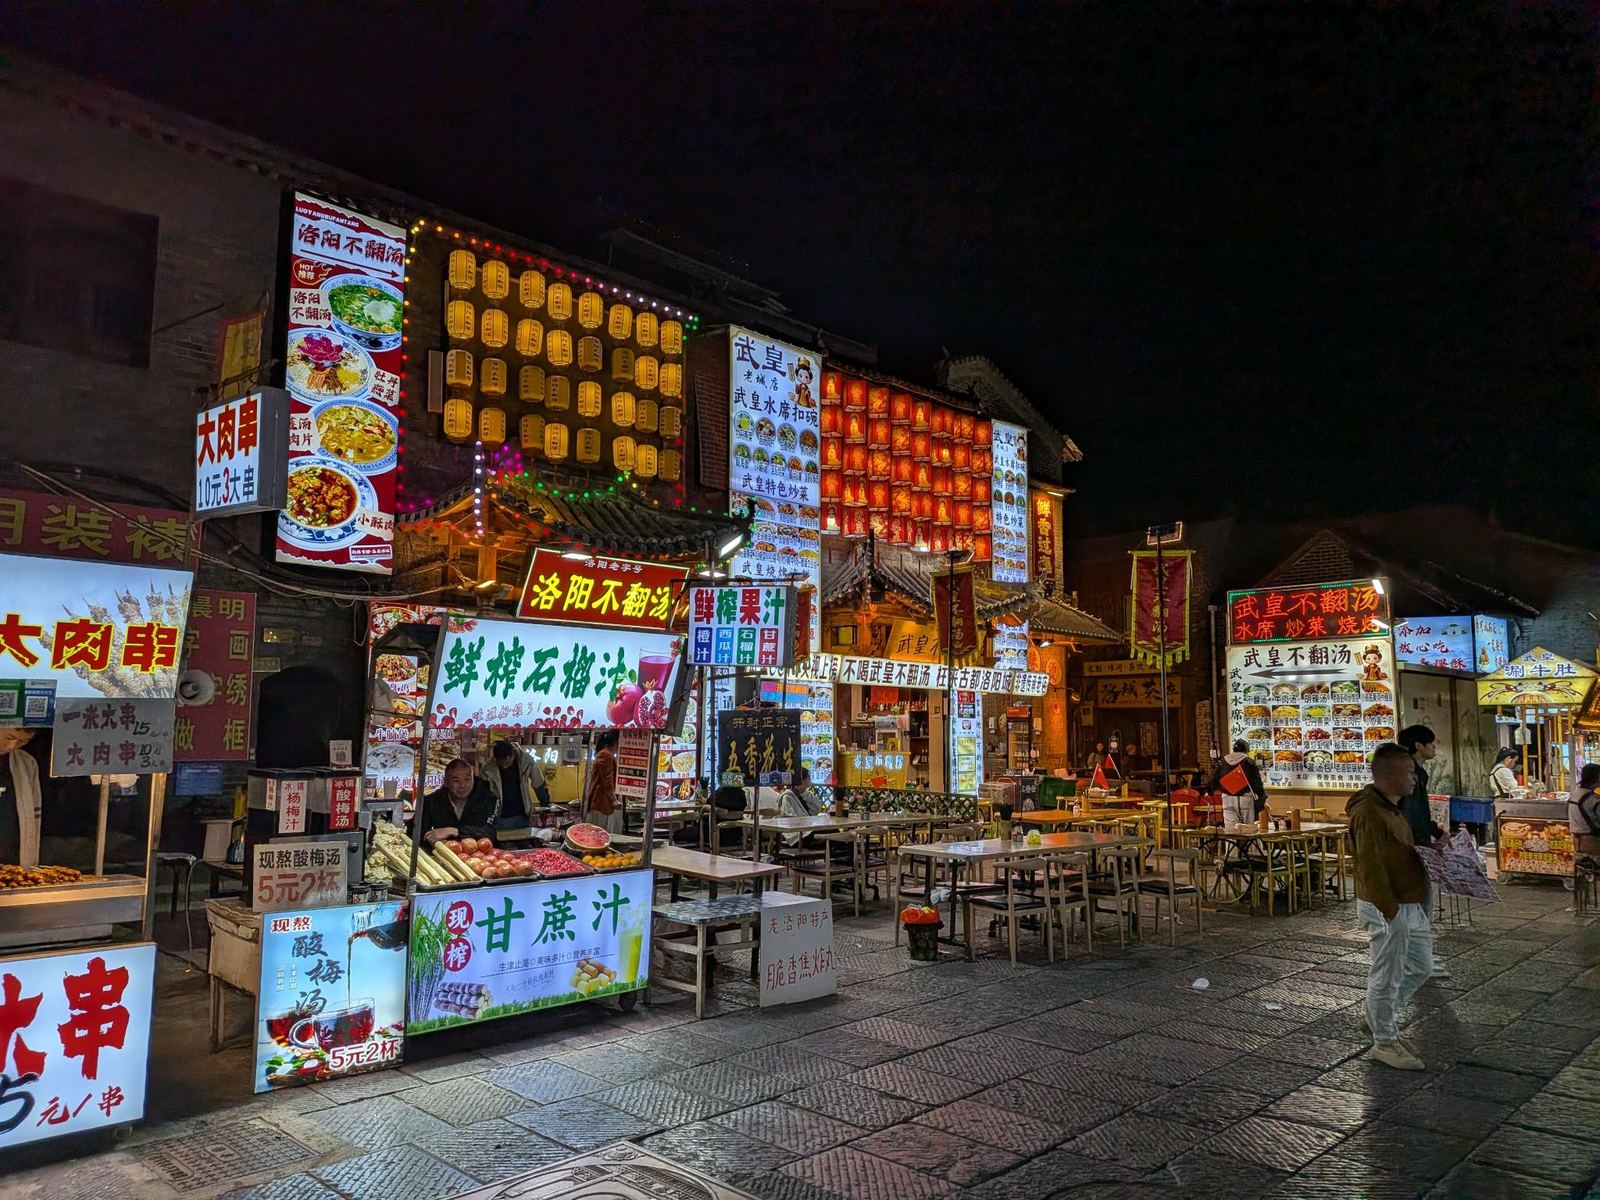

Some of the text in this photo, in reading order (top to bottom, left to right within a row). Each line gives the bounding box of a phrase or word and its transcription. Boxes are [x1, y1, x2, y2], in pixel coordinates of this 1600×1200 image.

[298, 223, 405, 267] 洛阳不翻汤
[298, 270, 316, 281] 推荐
[299, 263, 314, 272] HOT
[293, 291, 321, 305] 洛阳
[291, 307, 332, 321] 不翻汤
[734, 336, 787, 378] 武皇
[374, 370, 399, 388] 牡丹
[744, 368, 779, 392] 老城店
[734, 386, 819, 428] 武皇水席扣碗
[198, 396, 258, 468] 大肉串
[289, 433, 313, 447] 肉片
[993, 429, 1014, 447] 武皇
[198, 464, 255, 509] 10元3大串
[742, 472, 809, 502] 武皇特色炒菜
[358, 512, 394, 533] 小酥肉
[995, 511, 1024, 529] 特色炒菜
[585, 559, 643, 574] 洛阳老字号
[530, 571, 675, 620] 洛阳不翻汤
[694, 588, 785, 626] 鲜榨果汁
[1235, 586, 1380, 619] 武皇不翻汤
[1236, 613, 1381, 640] 水席 炒菜 烧烤
[1398, 624, 1432, 637] 添加
[0, 613, 180, 674] 大肉串
[696, 629, 711, 661] 橙汁
[717, 629, 732, 663] 西瓜汁
[740, 629, 755, 663] 石榴汁
[762, 629, 777, 665] 甘蔗汁
[1243, 644, 1351, 669] 武皇不翻汤
[1398, 640, 1450, 654] 放心吃
[1522, 652, 1555, 662] 武皇
[443, 635, 632, 703] 鲜榨石榴汁
[843, 659, 1013, 692] 不喝武皇不翻汤 枉来古都洛阳城
[1504, 663, 1577, 678] 涮牛肚
[1229, 668, 1246, 743] 武皇水席炒
[1274, 695, 1297, 704] 牛肉汤
[62, 702, 137, 731] 一米大串
[732, 716, 789, 729] 开封正宗
[66, 740, 137, 768] 大肉串
[285, 792, 301, 831] 杨梅汁
[336, 789, 351, 828] 酸梅汤
[259, 848, 341, 869] 现熬酸梅汤
[258, 870, 341, 905] 5元2杯
[271, 916, 311, 933] 现熬
[475, 883, 631, 954] 甘蔗汁
[768, 908, 829, 934] 老洛阳特产
[445, 908, 470, 969] 现榨
[291, 931, 346, 1016] 酸梅汤
[498, 958, 530, 972] 生津止渴
[766, 946, 835, 992] 脆香焦炸丸
[331, 1039, 399, 1070] 5元2杯
